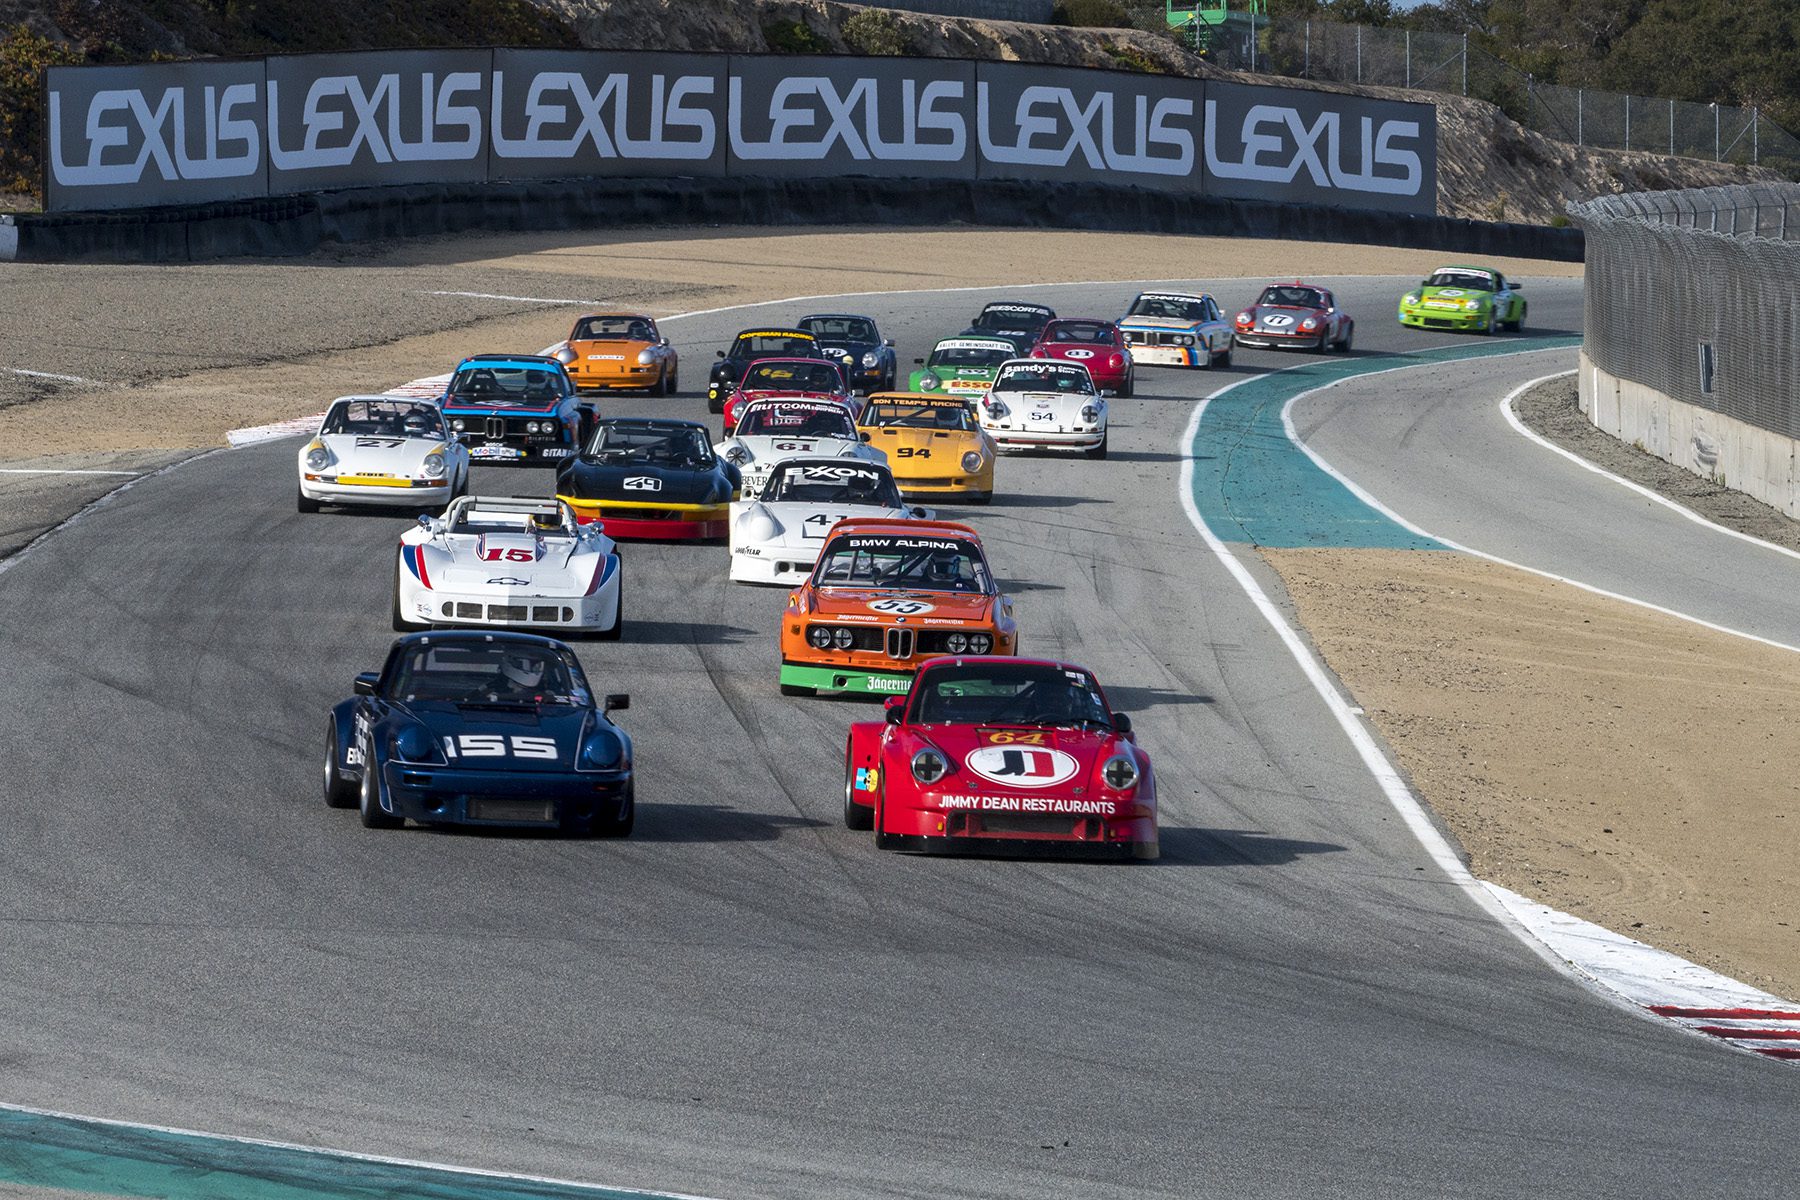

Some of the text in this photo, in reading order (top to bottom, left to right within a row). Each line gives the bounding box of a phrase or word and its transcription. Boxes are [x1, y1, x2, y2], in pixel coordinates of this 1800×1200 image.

[492, 71, 716, 158] LEXUS
[729, 76, 967, 161] LEXUS
[267, 72, 482, 171] LEXUS
[977, 81, 1194, 176] LEXUS
[50, 84, 259, 186] LEXUS
[1205, 100, 1422, 196] LEXUS
[1140, 295, 1202, 304] SCHNITZER
[1268, 315, 1288, 324] 77
[782, 332, 815, 341] RACING
[1004, 363, 1057, 374] sandy's
[951, 381, 993, 389] ESSO
[1031, 412, 1054, 421] 54
[357, 439, 403, 448] 27
[776, 442, 813, 452] 61
[473, 447, 500, 457] Mobil
[897, 447, 931, 459] 94
[785, 465, 879, 481] EXXON
[625, 478, 660, 490] 49
[849, 539, 959, 550] BMW ALPINA
[483, 548, 534, 563] 15
[874, 600, 928, 614] 55
[989, 732, 1045, 745] 64
[443, 735, 558, 759] 155
[938, 795, 1116, 814] JIMMY DEAN RESTAURANTS
